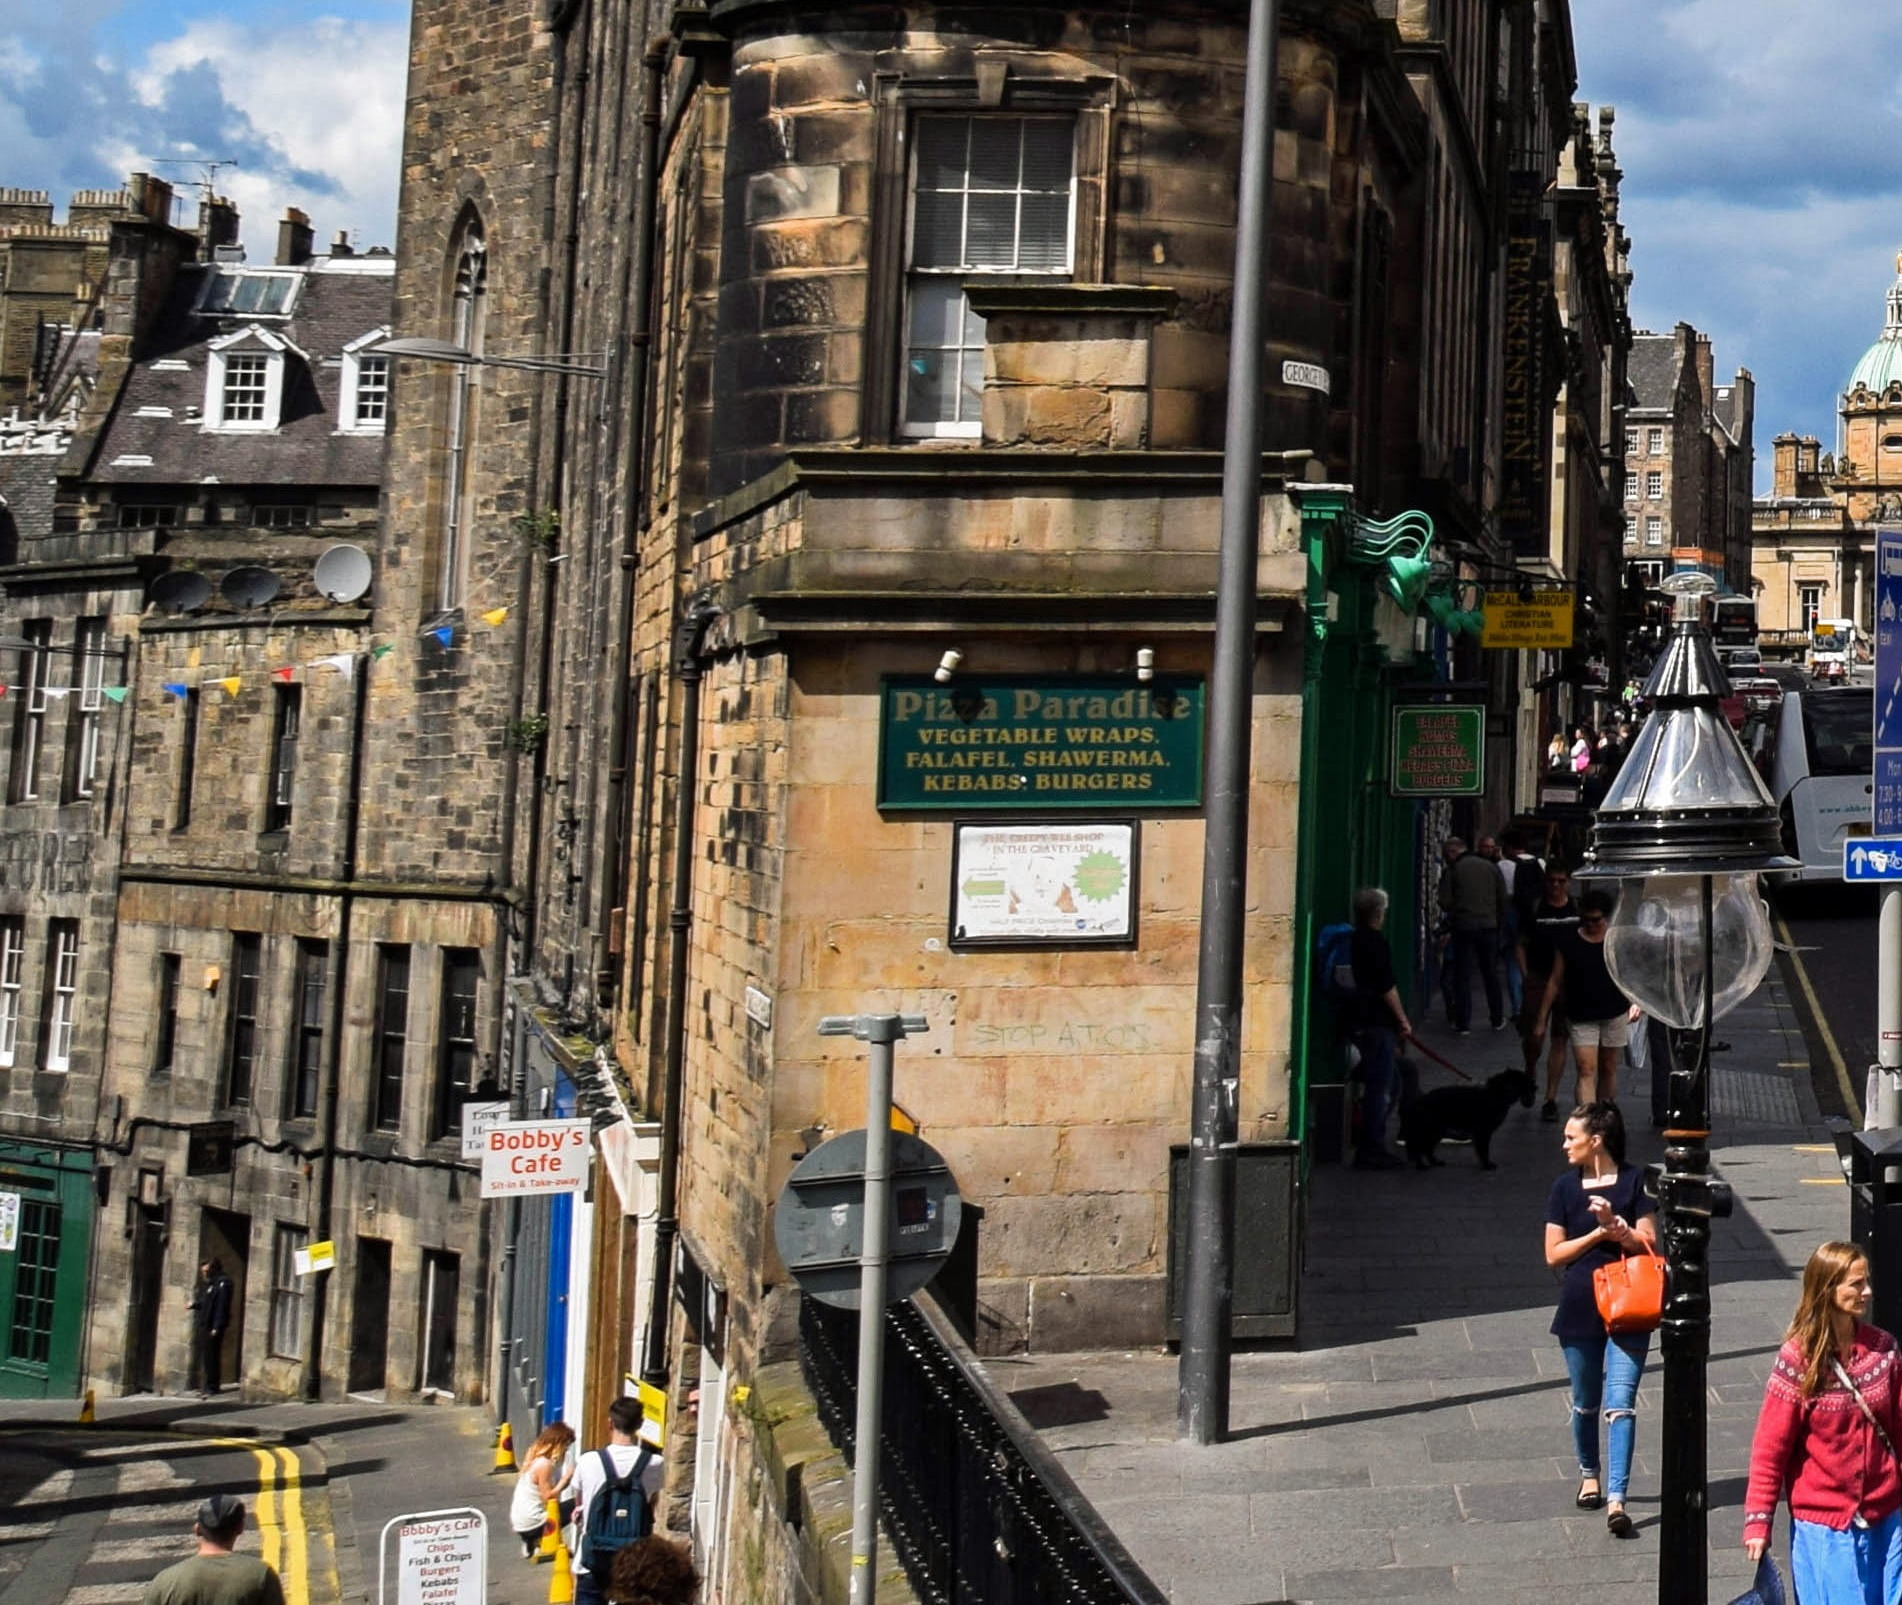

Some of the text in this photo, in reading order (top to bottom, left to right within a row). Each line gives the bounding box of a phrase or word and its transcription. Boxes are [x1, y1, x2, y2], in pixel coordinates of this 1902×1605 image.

[918, 727, 1058, 746] VEGETABLE
[1035, 772, 1153, 791] BURGERS
[974, 1022, 1047, 1047] STOP
[490, 1127, 584, 1151] Bobby's
[511, 1153, 562, 1174] Cafe
[401, 1518, 481, 1537] Bobby's Cafe
[427, 1543, 455, 1553] Chips
[408, 1552, 473, 1567] Fish & Chips
[420, 1564, 460, 1577] Burgers
[421, 1577, 459, 1588] Kebabs
[422, 1588, 458, 1600] Falafel
